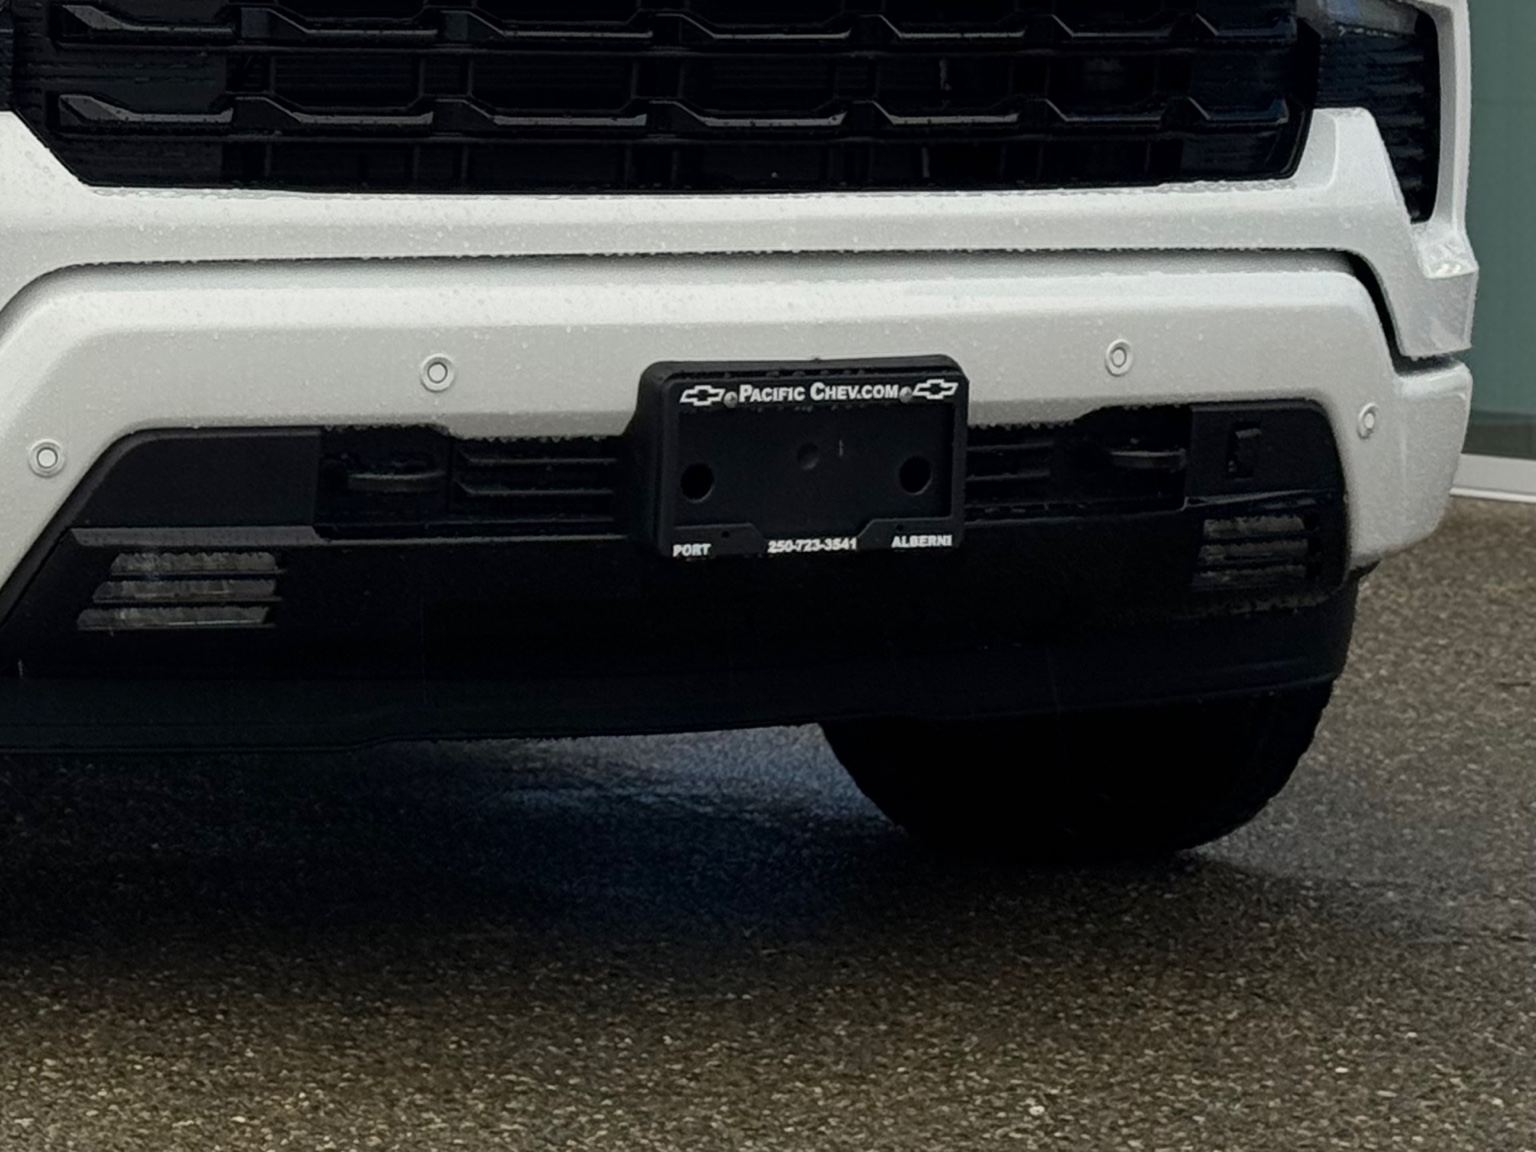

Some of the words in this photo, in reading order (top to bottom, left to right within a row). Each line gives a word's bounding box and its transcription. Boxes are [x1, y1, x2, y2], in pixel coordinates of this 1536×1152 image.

[738, 384, 806, 403] PACIFIC
[810, 381, 899, 401] CHEV.COM
[672, 544, 711, 557] PORT
[891, 534, 952, 549] ALBERNI
